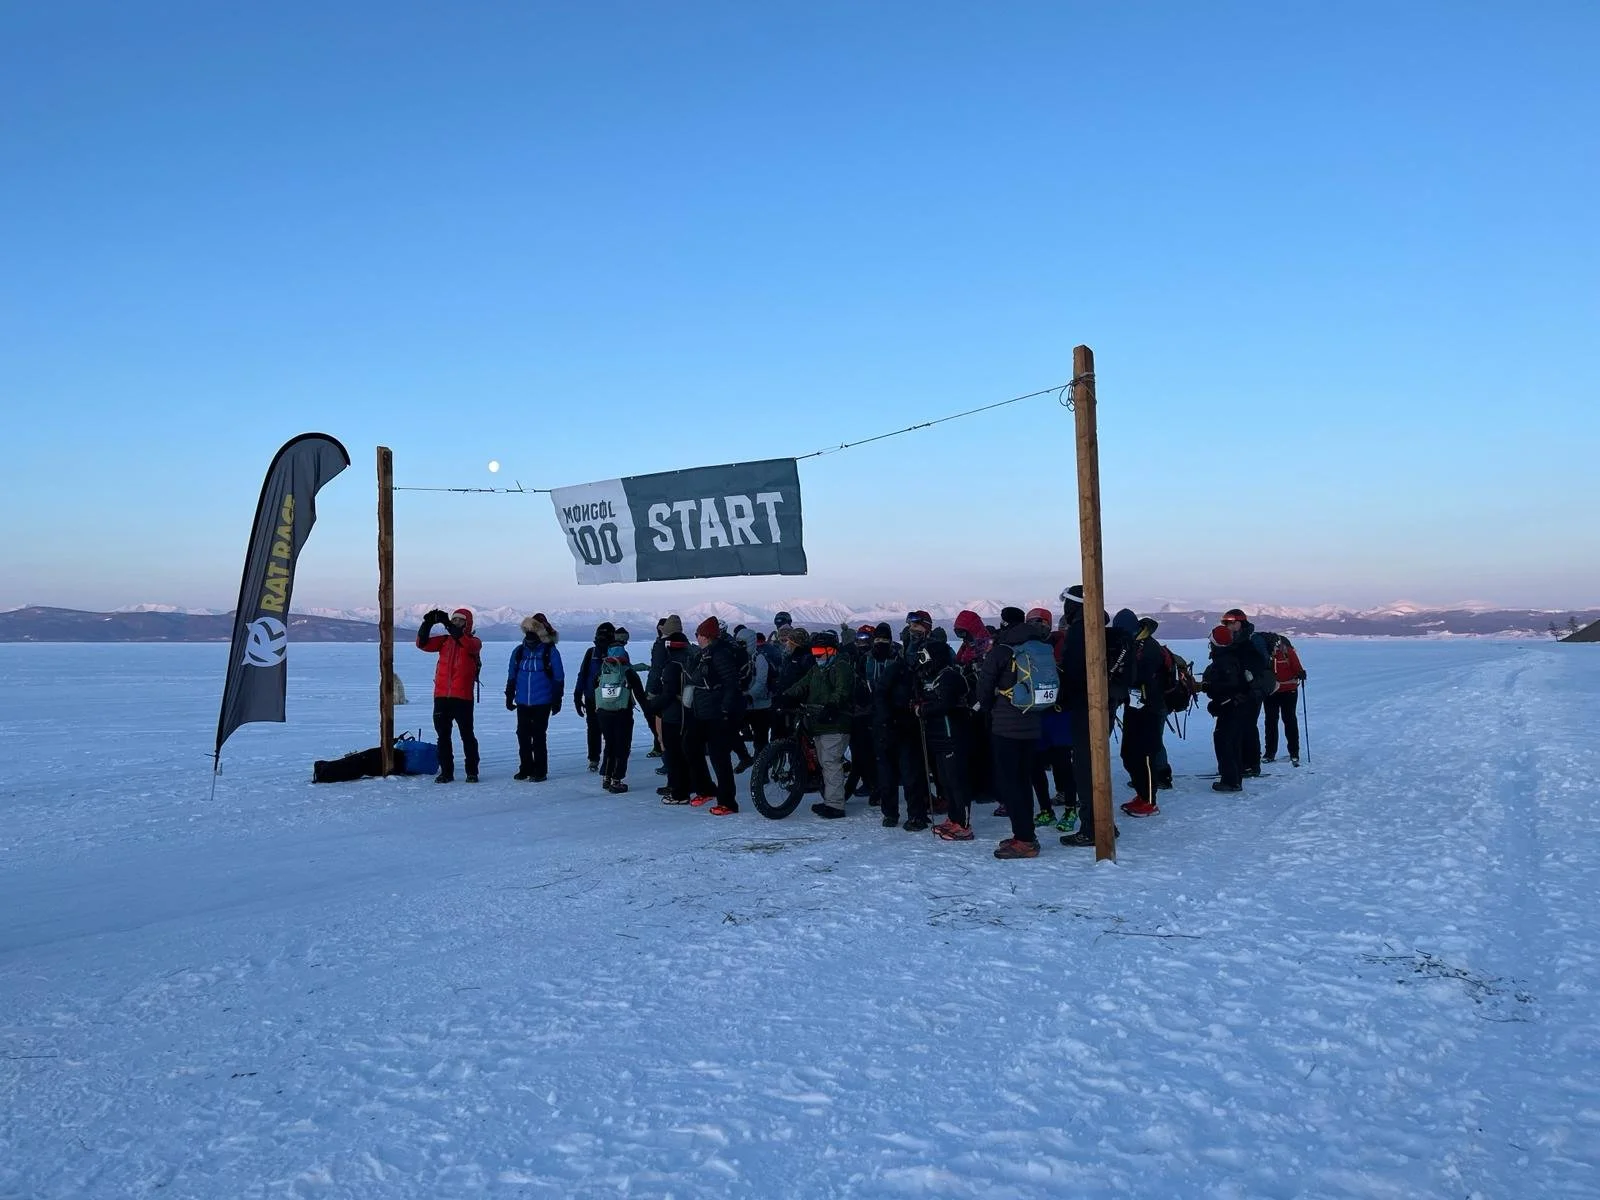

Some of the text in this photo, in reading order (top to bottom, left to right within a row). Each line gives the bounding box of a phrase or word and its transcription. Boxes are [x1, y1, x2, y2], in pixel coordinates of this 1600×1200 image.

[569, 522, 624, 566] 100
[648, 491, 784, 552] START
[261, 561, 289, 613] RAT
[1043, 690, 1054, 699] 46
